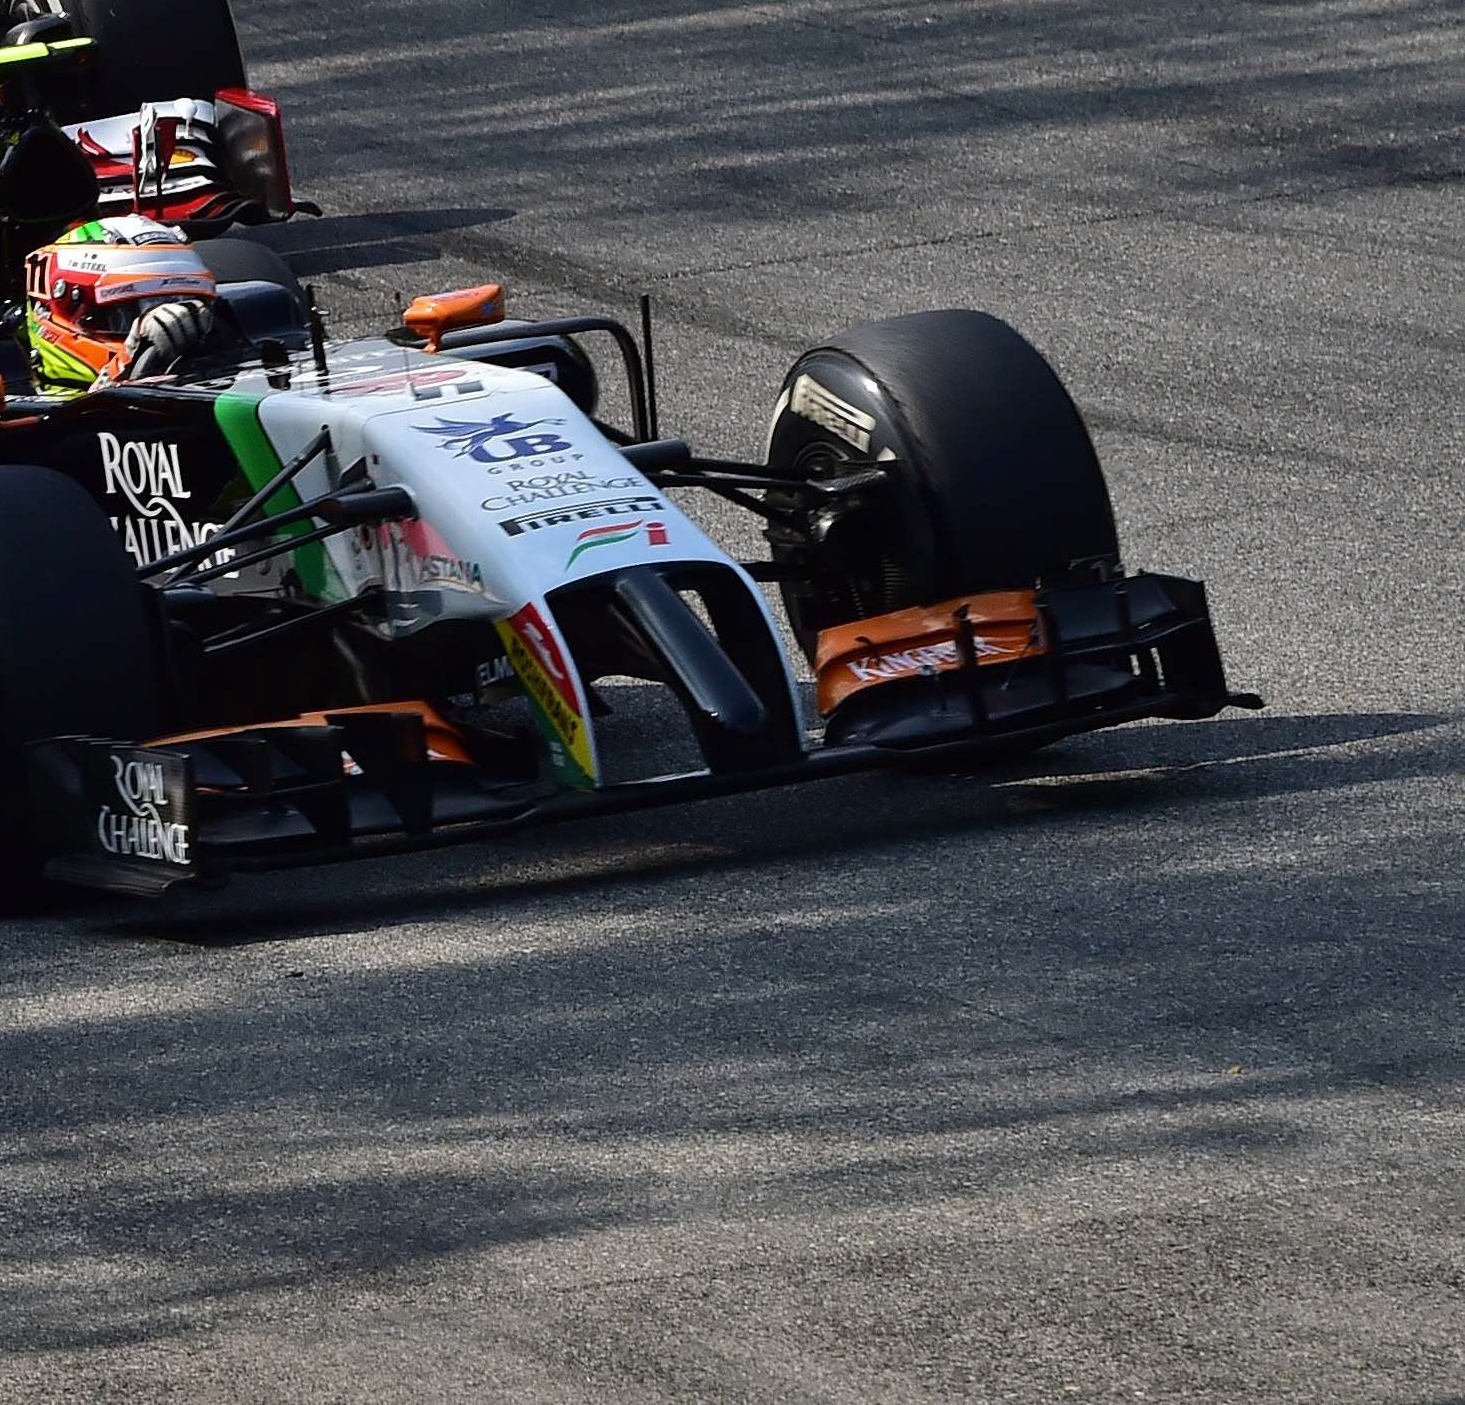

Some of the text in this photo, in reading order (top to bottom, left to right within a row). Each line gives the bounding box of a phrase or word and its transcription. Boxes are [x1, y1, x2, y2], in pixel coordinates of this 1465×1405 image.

[96, 431, 192, 518] ROYAL
[486, 452, 586, 475] GROUP
[505, 470, 597, 494] ROYAL
[480, 476, 647, 513] CHALLENGE
[497, 495, 667, 538] PIRELLI
[97, 803, 191, 865] CHALLENGE
